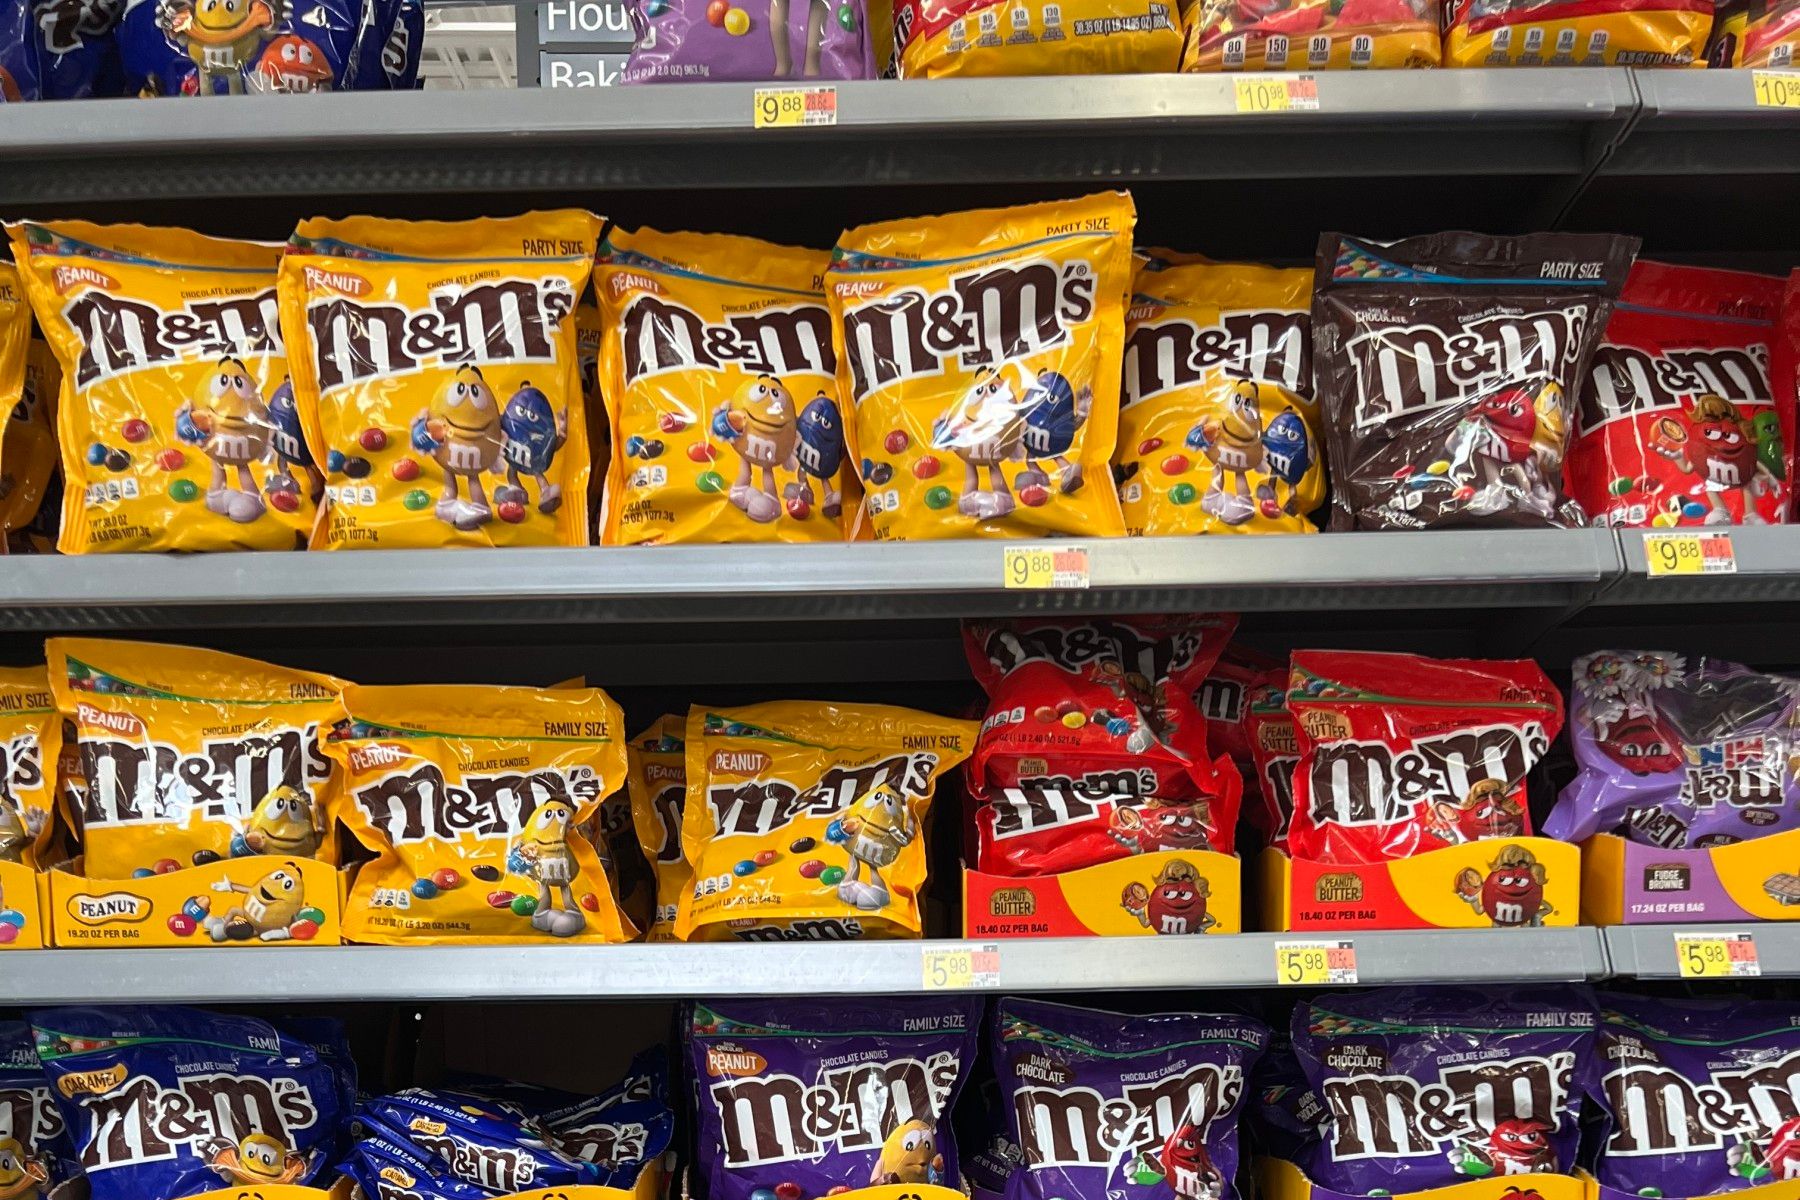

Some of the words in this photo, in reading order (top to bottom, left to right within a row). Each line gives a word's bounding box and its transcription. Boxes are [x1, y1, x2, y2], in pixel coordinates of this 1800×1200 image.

[548, 0, 628, 31] Flou
[1227, 40, 1241, 53] 80
[1267, 38, 1287, 52] 150
[1313, 38, 1327, 52] 90
[1046, 220, 1082, 237] PARTY
[1085, 216, 1111, 231] SIZE
[523, 239, 557, 256] PARTY
[559, 239, 585, 255] SIZE
[57, 265, 111, 290] PEANUT
[1539, 262, 1576, 279] PARTY
[1577, 262, 1604, 280] SIZE
[304, 267, 362, 295] PEANUT
[611, 272, 660, 294] PEANUT
[835, 280, 884, 298] PEANUT
[27, 691, 51, 708] SIZE
[77, 706, 138, 733] PEANUT
[1307, 709, 1338, 726] PEANUT
[543, 721, 582, 737] FAMILY
[585, 721, 609, 737] SIZE
[458, 761, 499, 772] CHOCOLATE
[500, 757, 530, 769] CANDIES
[715, 751, 764, 773] PEANUT
[1324, 877, 1354, 888] PEANUT
[1654, 870, 1680, 880] FUDGE
[1648, 879, 1684, 890] BROWNIE
[998, 891, 1027, 902] PEANUT
[1319, 887, 1360, 901] BUTTER
[80, 899, 137, 919] PEANUT
[993, 901, 1032, 915] BUTTER
[975, 924, 999, 934] 18.40
[1000, 924, 1011, 934] OZ
[1012, 924, 1029, 934] PER
[1030, 923, 1049, 933] BAG
[903, 1017, 941, 1032] FAMILY
[942, 1014, 966, 1028] SIZE
[1526, 1013, 1566, 1027] FAMILY
[1569, 1013, 1594, 1026] SIZE
[1201, 1029, 1237, 1040] FAMILY
[1241, 1030, 1262, 1045] SIZE
[1342, 1045, 1368, 1056] DARK
[709, 1052, 757, 1071] PEANUT
[1030, 1054, 1051, 1070] DARK
[1327, 1055, 1383, 1070] CHOCOLATE
[1016, 1064, 1066, 1084] CHOCOLATE
